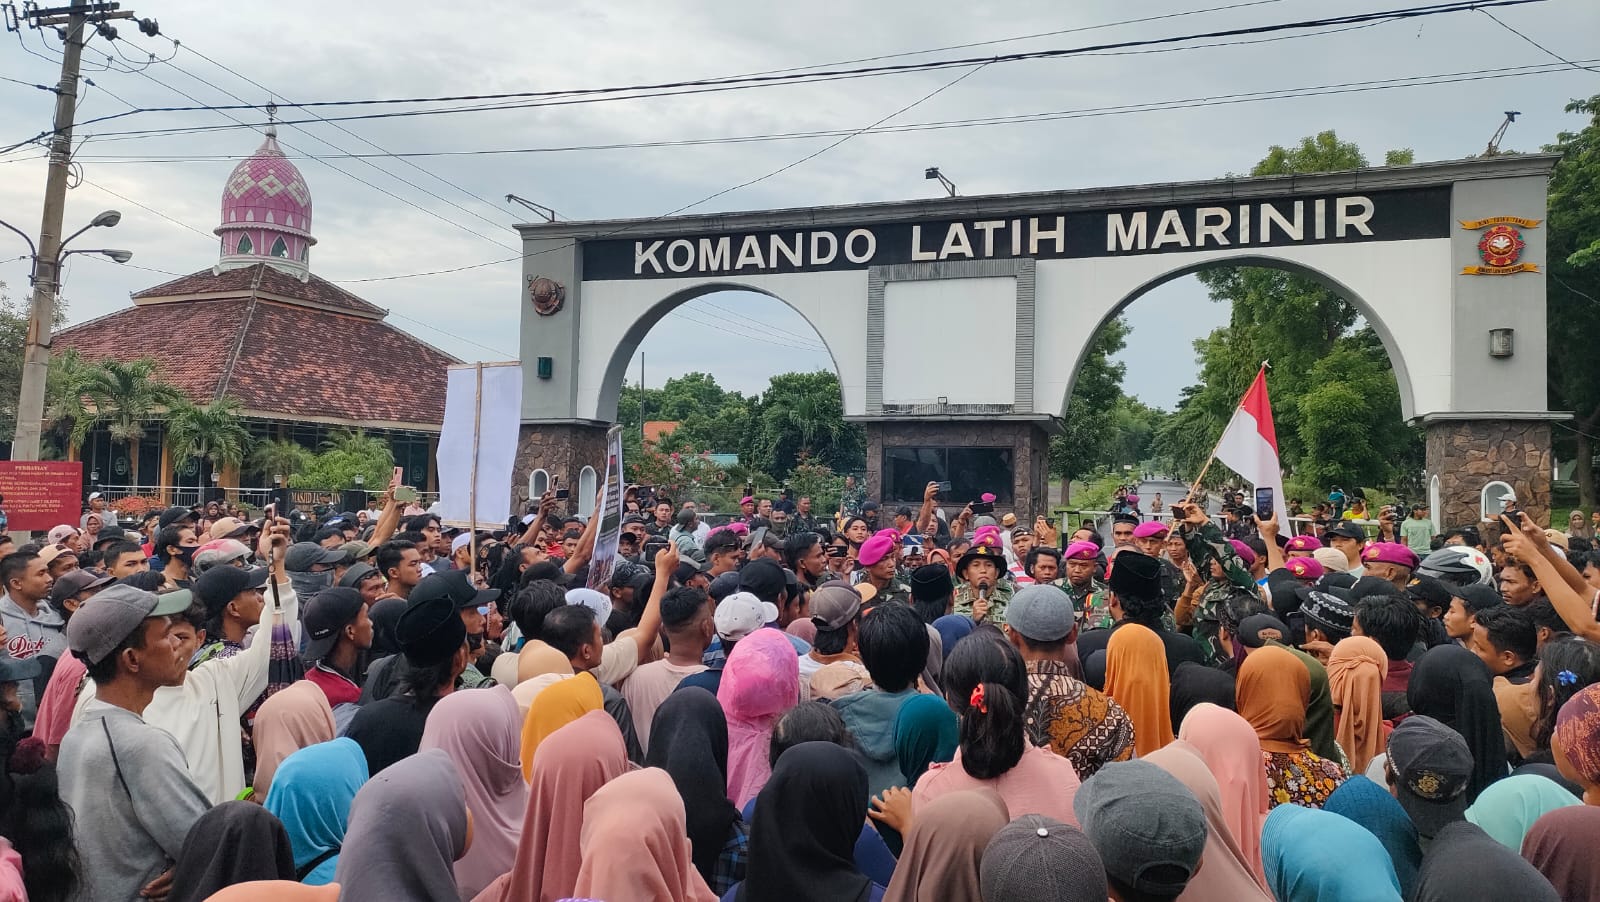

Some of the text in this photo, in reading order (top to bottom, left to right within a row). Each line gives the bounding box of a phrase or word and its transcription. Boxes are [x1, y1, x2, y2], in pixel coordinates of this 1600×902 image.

[634, 196, 1375, 275] KOMANDO LATIH MARINIR
